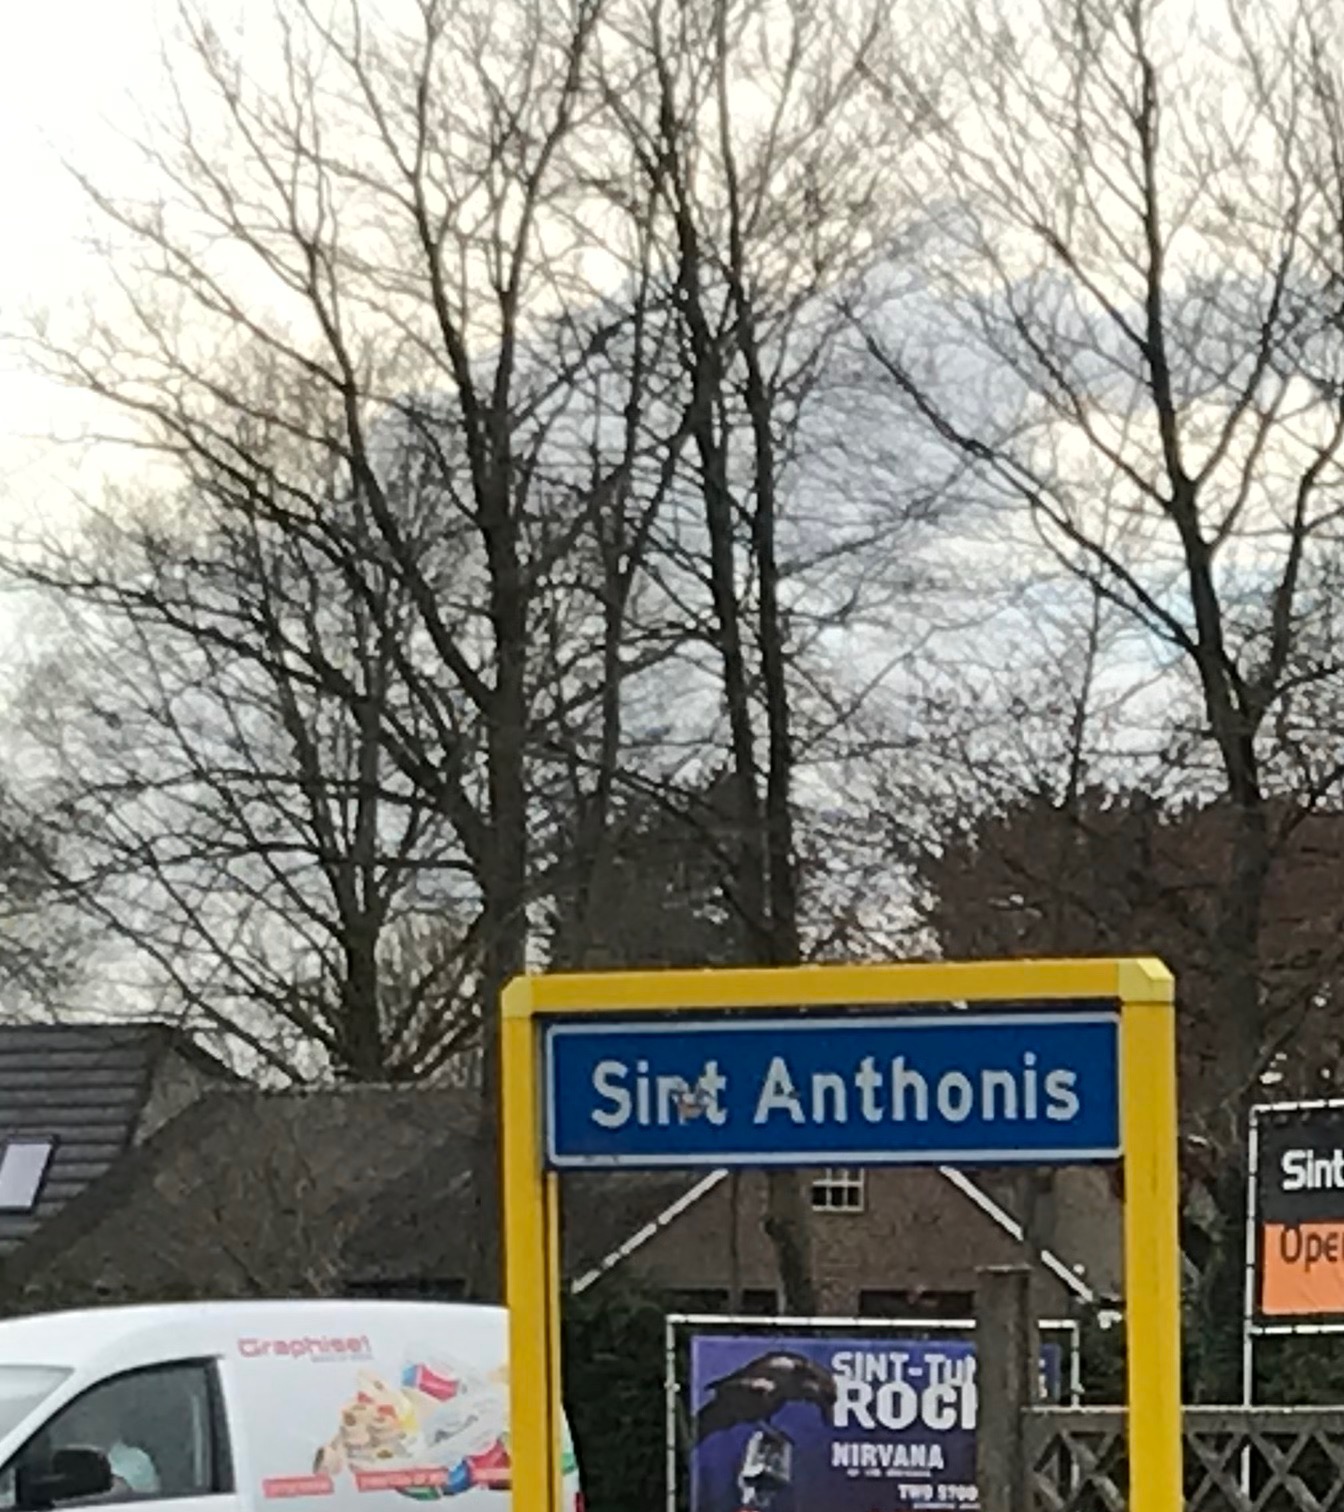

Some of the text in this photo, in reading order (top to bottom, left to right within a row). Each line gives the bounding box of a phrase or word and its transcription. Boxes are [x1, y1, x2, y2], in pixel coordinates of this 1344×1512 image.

[591, 1051, 1080, 1129] Sint Anthonis
[831, 1441, 944, 1469] NIRVANA
